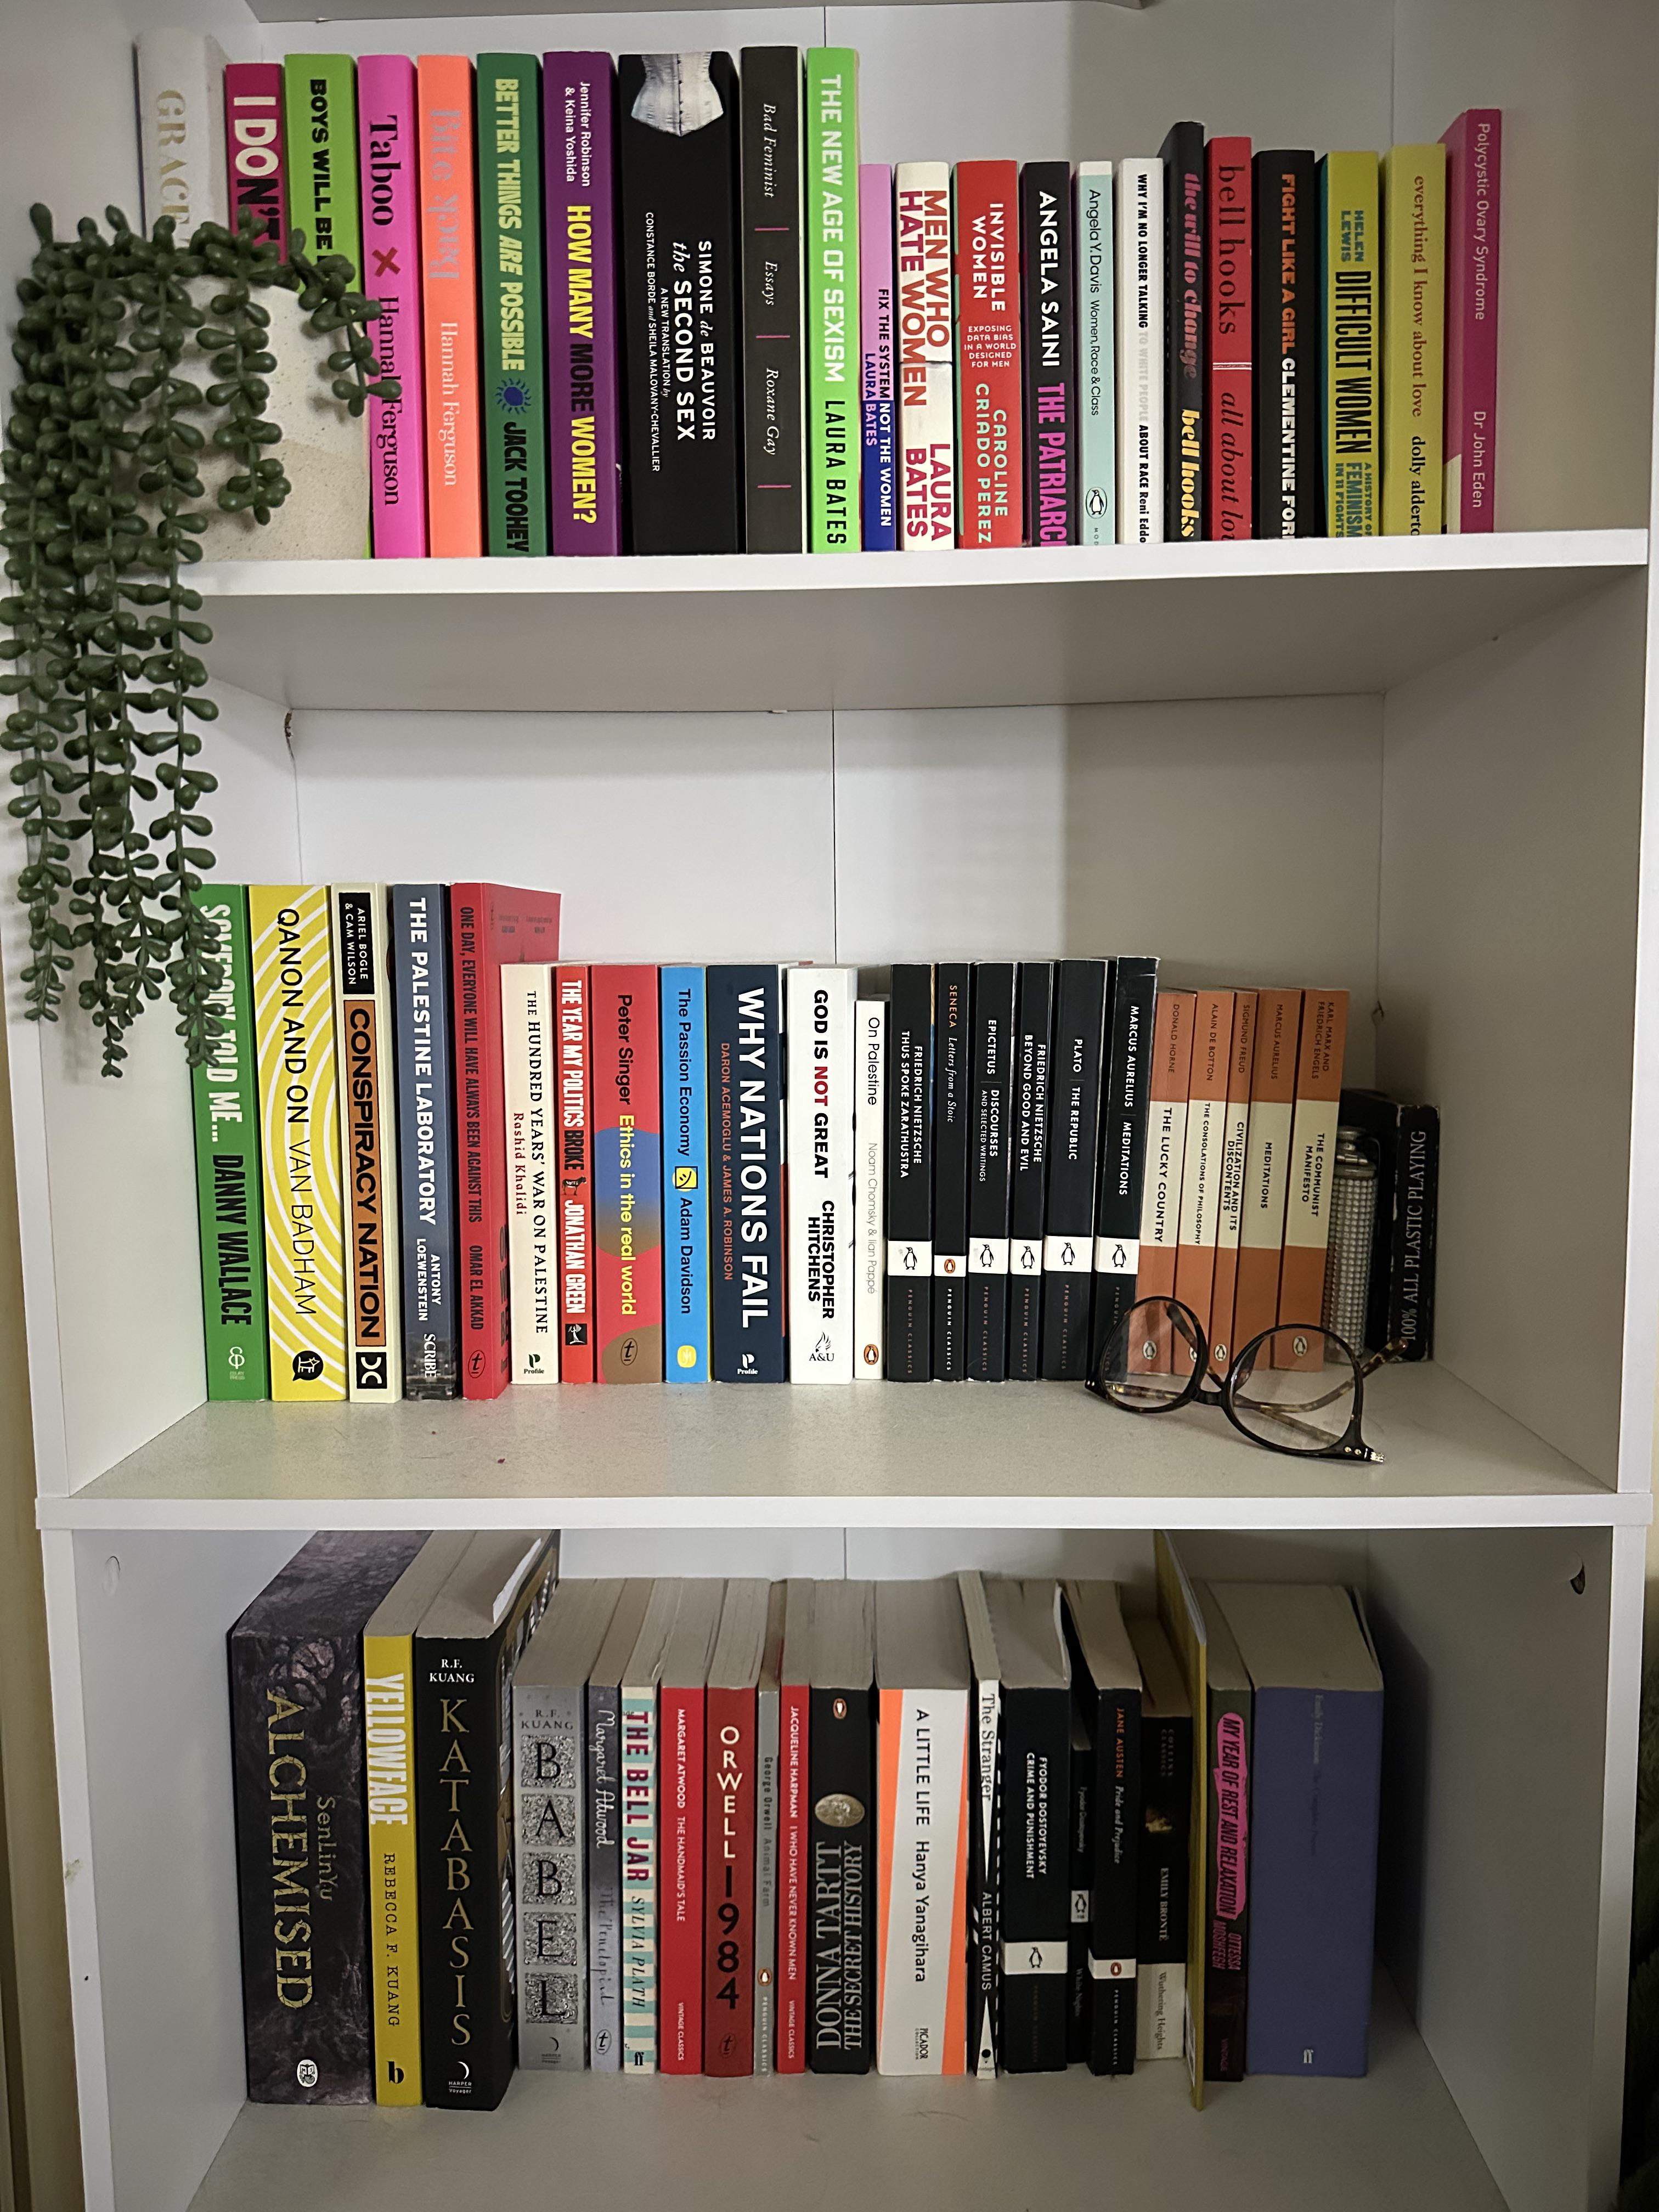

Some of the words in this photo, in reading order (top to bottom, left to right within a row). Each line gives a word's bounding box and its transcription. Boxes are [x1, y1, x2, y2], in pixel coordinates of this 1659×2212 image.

[309, 79, 328, 143] BOYS
[495, 79, 520, 153] BETTER
[564, 99, 576, 133] Keina
[565, 88, 575, 96] &
[578, 82, 591, 128] Jennifer
[763, 104, 777, 133] Bad
[312, 149, 331, 211] WILL
[370, 115, 401, 225] Taboo
[566, 136, 577, 182] Yoshida
[580, 131, 592, 187] Robinson
[764, 136, 778, 198] Feminist
[1474, 123, 1490, 195] Polycystic
[497, 161, 521, 229] THINGS
[1086, 189, 1101, 239] Angela
[1218, 165, 1245, 225] bell
[1474, 201, 1490, 242] Ovary
[315, 218, 332, 251] BE
[499, 235, 522, 274] ARE
[567, 206, 591, 262] HOW
[646, 213, 654, 269] CONSTANCE
[673, 242, 691, 272] the
[972, 216, 987, 298] WOMEN
[989, 203, 1005, 311] INVISIBLE
[1040, 191, 1058, 295] ANGELA
[1090, 241, 1101, 252] Y.
[647, 272, 655, 303] BORDE
[698, 241, 713, 314] SIMONE
[763, 261, 778, 306] Essays
[1090, 255, 1102, 293] Davis
[1219, 238, 1245, 334] hooks
[1473, 246, 1489, 320] Syndrome
[500, 282, 524, 370] POSSIBLE
[568, 268, 593, 338] MANY
[647, 306, 656, 321] and
[700, 321, 713, 336] de
[1088, 300, 1100, 345] Women,
[1335, 271, 1371, 372] DIFFICULT
[440, 322, 458, 395] Hannah
[648, 323, 657, 357] SHEILA
[661, 320, 670, 386] TRANSLATION
[675, 281, 693, 383] SECOND
[1042, 302, 1059, 366] SAINI
[569, 343, 595, 411] MORE
[1091, 346, 1100, 374] Race
[649, 360, 660, 471] MALOVANY-CHEVALLIER
[660, 389, 671, 397] by
[676, 392, 695, 441] SEX
[700, 343, 715, 440] BEAUVOIR
[766, 369, 779, 420] Roxane
[1091, 386, 1101, 415] Class
[1335, 376, 1371, 454] WOMEN
[438, 401, 460, 486] Ferguson
[503, 422, 527, 471] JACK
[765, 426, 779, 455] Gay
[825, 401, 846, 469] LAURA
[975, 384, 990, 467] CRIADO
[1473, 412, 1486, 428] Dr
[571, 417, 596, 524] WOMEN?
[994, 410, 1008, 516] CAROLINE
[1472, 433, 1486, 467] John
[504, 478, 529, 551] TOOHEY
[826, 479, 847, 544] BATES
[978, 478, 991, 543] PEREZ
[1472, 473, 1485, 507] Eden
[345, 913, 354, 938] CAM
[357, 907, 367, 940] ARIEL
[276, 907, 308, 1007] QANON
[346, 940, 356, 984] WILSON
[358, 944, 369, 979] BOGLE
[285, 1018, 308, 1074] AND
[738, 988, 765, 1069] WHY
[946, 1037, 957, 1066] Letters
[988, 1020, 996, 1074] EPICTETUS
[1073, 1039, 1083, 1072] PLATO
[1128, 1006, 1139, 1051] MARCUS
[720, 1042, 730, 1083] DARON
[946, 1068, 956, 1090] from
[1125, 1056, 1136, 1107] AURELIUS
[286, 1084, 309, 1124] ON
[348, 1008, 376, 1212] CONSPIRACY
[721, 1086, 731, 1152] ACEMOGLU
[947, 1101, 956, 1122] Stoic
[990, 1090, 999, 1156] DISCOURSES
[1071, 1087, 1081, 1107] THE
[1162, 1108, 1172, 1132] THE
[514, 1113, 527, 1160] Rashid
[740, 1080, 768, 1242] NATIONS
[1069, 1110, 1080, 1159] REPUBLIC
[1119, 1122, 1132, 1195] MEDITATIONS
[1159, 1137, 1170, 1178] LUCKY
[515, 1165, 528, 1215] Khalidi
[723, 1165, 732, 1203] JAMES
[1302, 1146, 1312, 1202] MANIFESTO
[1312, 1155, 1323, 1216] COMMUNIST
[1408, 1131, 1426, 1199] PLAYING
[723, 1207, 732, 1217] A.
[1155, 1182, 1166, 1242] COUNTRY
[1404, 1205, 1422, 1268] PLASTIC
[724, 1221, 733, 1279] ROBINSON
[357, 1222, 380, 1338] NATION
[741, 1255, 768, 1327] FAIL
[1403, 1274, 1418, 1302] ALL
[430, 1673, 475, 1683] KUANG
[626, 1711, 649, 1756] THE
[789, 1706, 799, 1765] JACQUELINE
[917, 1709, 929, 1720] A
[1115, 1707, 1125, 1734] JANE
[365, 1673, 408, 1824] YELLOWFACE
[916, 1729, 930, 1784] LITTLE
[1026, 1753, 1035, 1784] CRIME
[1115, 1737, 1125, 1778] AUSTEN
[626, 1768, 649, 1824] BELL
[717, 1726, 742, 1858] ORWELL
[789, 1768, 798, 1817] HARPMAN
[1026, 1786, 1035, 1809] AND
[1038, 1757, 1047, 1798] FYODOR
[916, 1791, 930, 1825] LIFE
[267, 1688, 314, 2010] ALCHEMISED
[317, 1796, 338, 1900] SenLinYu
[627, 1836, 649, 1881] JAR
[1025, 1813, 1035, 1878] PUNISHMENT
[1038, 1801, 1047, 1874] DOSTOYEVSKY
[438, 1699, 475, 2045] KATABASIS
[536, 1742, 566, 2019] BABEL
[816, 1842, 842, 1938] TARTT
[912, 1841, 929, 1891] Hanya
[1160, 1867, 1169, 1897] EMILY
[384, 1853, 398, 1935] REBECCA
[981, 1892, 991, 1942] ALBERT
[631, 1896, 645, 1948] SYLVIA
[716, 1865, 739, 2008] 1984
[912, 1894, 929, 1982] Yanagihara
[386, 1944, 399, 1957] F.
[981, 1945, 991, 1990] CAMUS
[387, 1966, 400, 2026] KUANG
[631, 1956, 645, 2008] PLATH
[816, 1949, 841, 2049] DONNA
[920, 2028, 928, 2059] PICADOR
